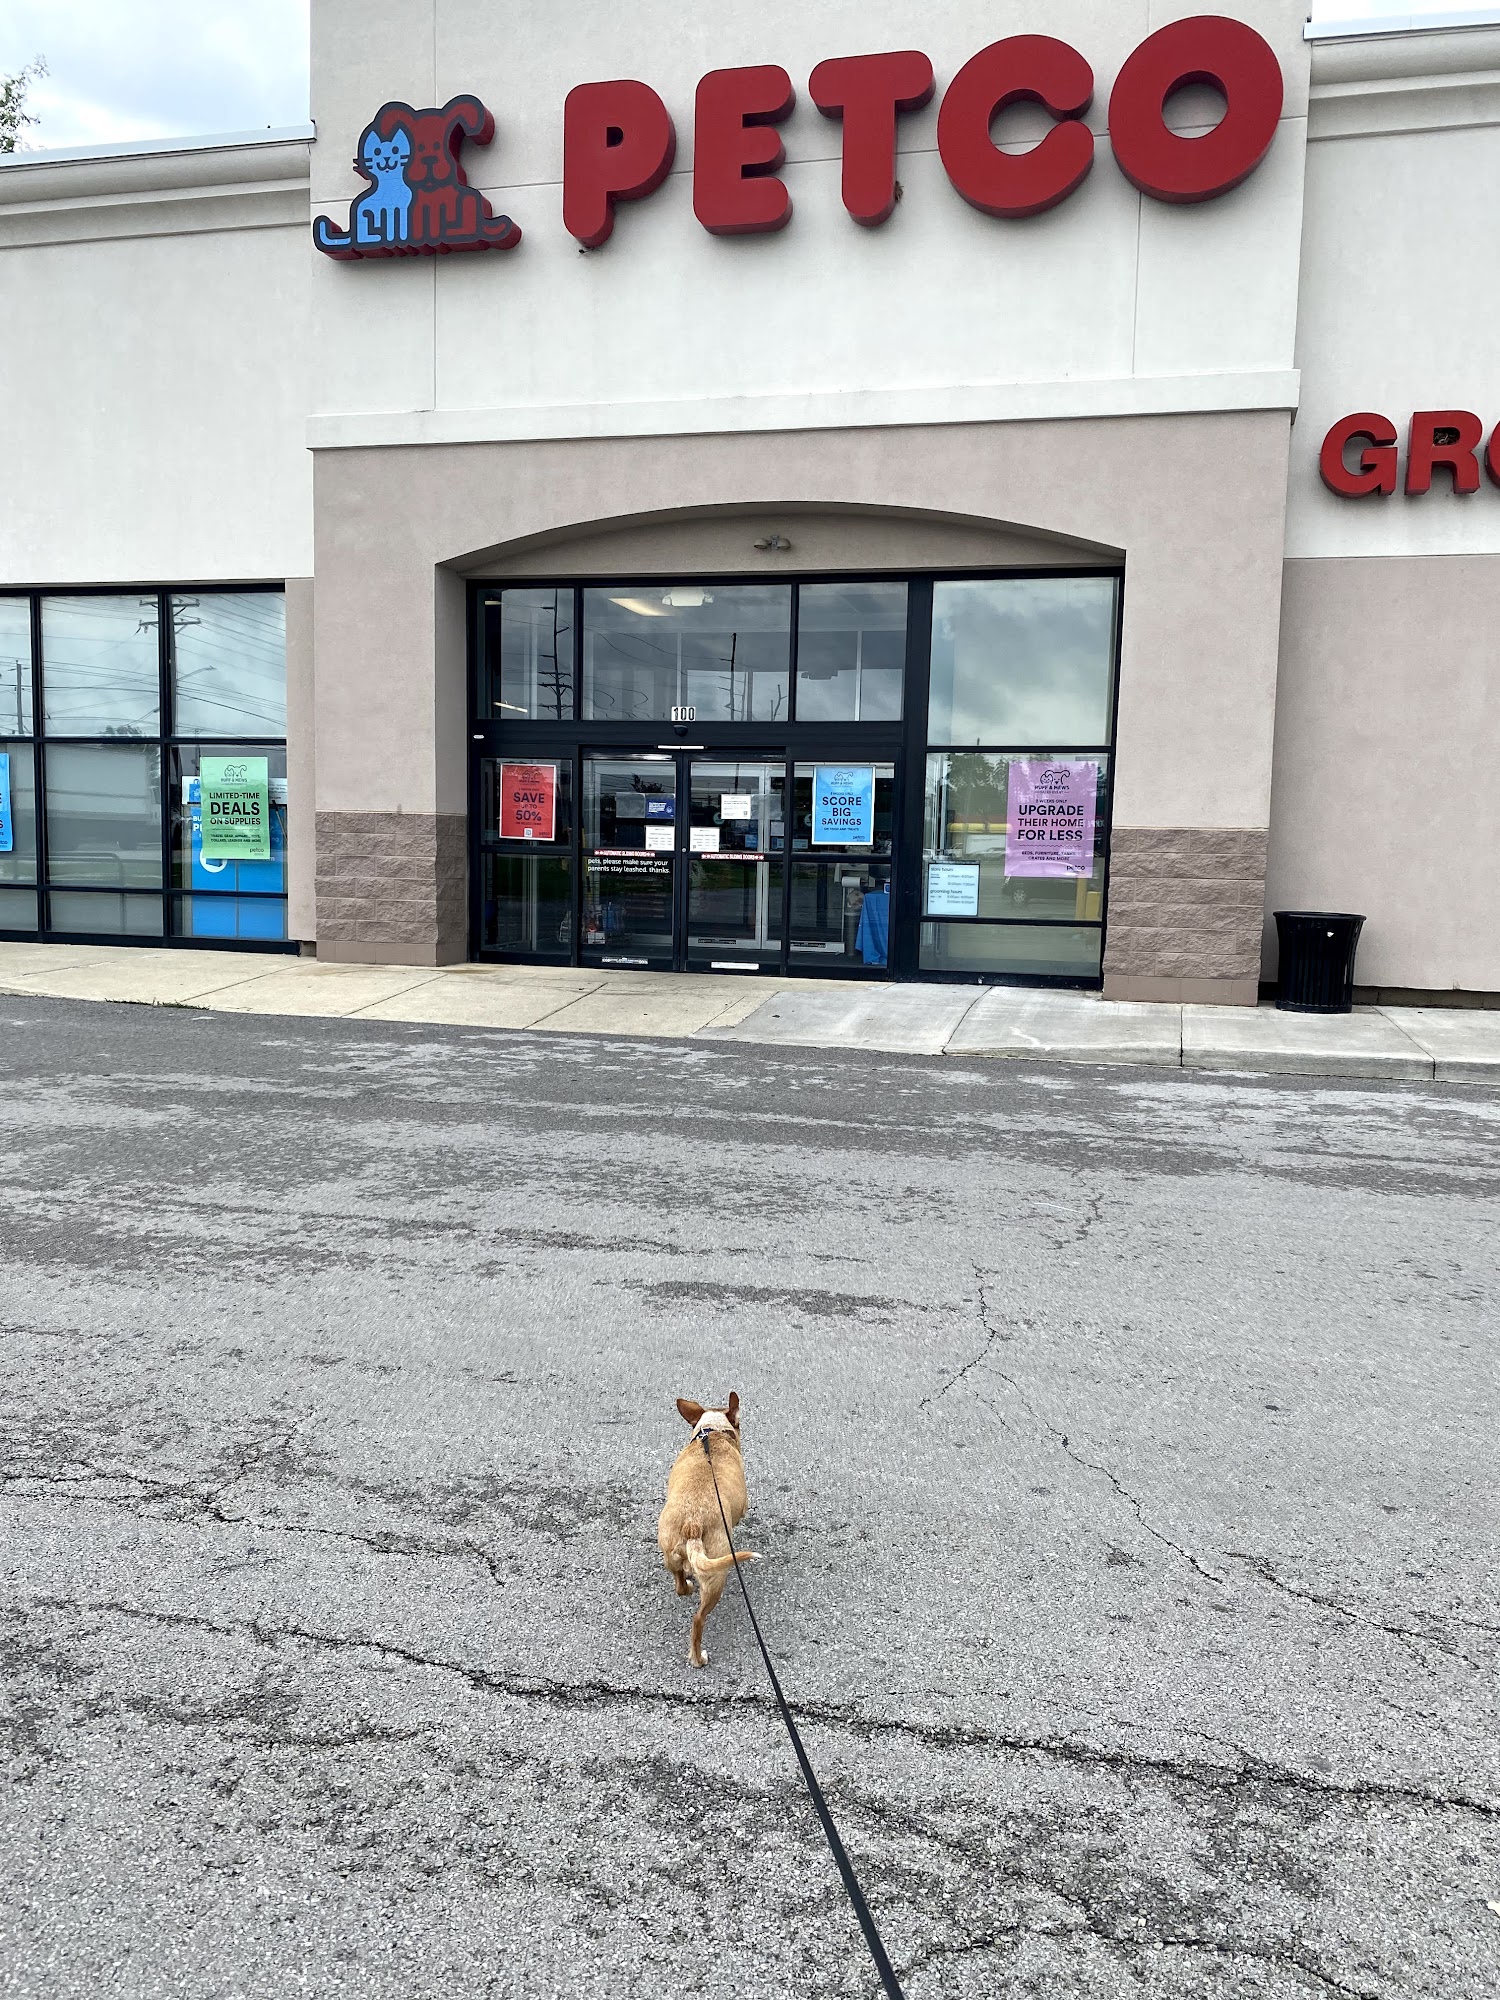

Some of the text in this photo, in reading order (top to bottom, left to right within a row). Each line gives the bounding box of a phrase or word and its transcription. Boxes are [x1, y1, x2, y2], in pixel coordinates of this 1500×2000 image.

[563, 15, 1284, 248] PETCO
[1319, 410, 1500, 499] GR
[673, 707, 695, 721] 100
[513, 792, 545, 804] SAVE
[822, 796, 862, 806] SCORE
[210, 801, 260, 815] DEALS
[832, 807, 851, 817] BIG
[1018, 804, 1084, 816] UPGRADE
[515, 810, 542, 821] 50%
[821, 818, 862, 826] SAVINGS
[1017, 818, 1048, 826] THEIR
[1050, 819, 1084, 827] HOME
[1017, 829, 1083, 841] FOR LESS
